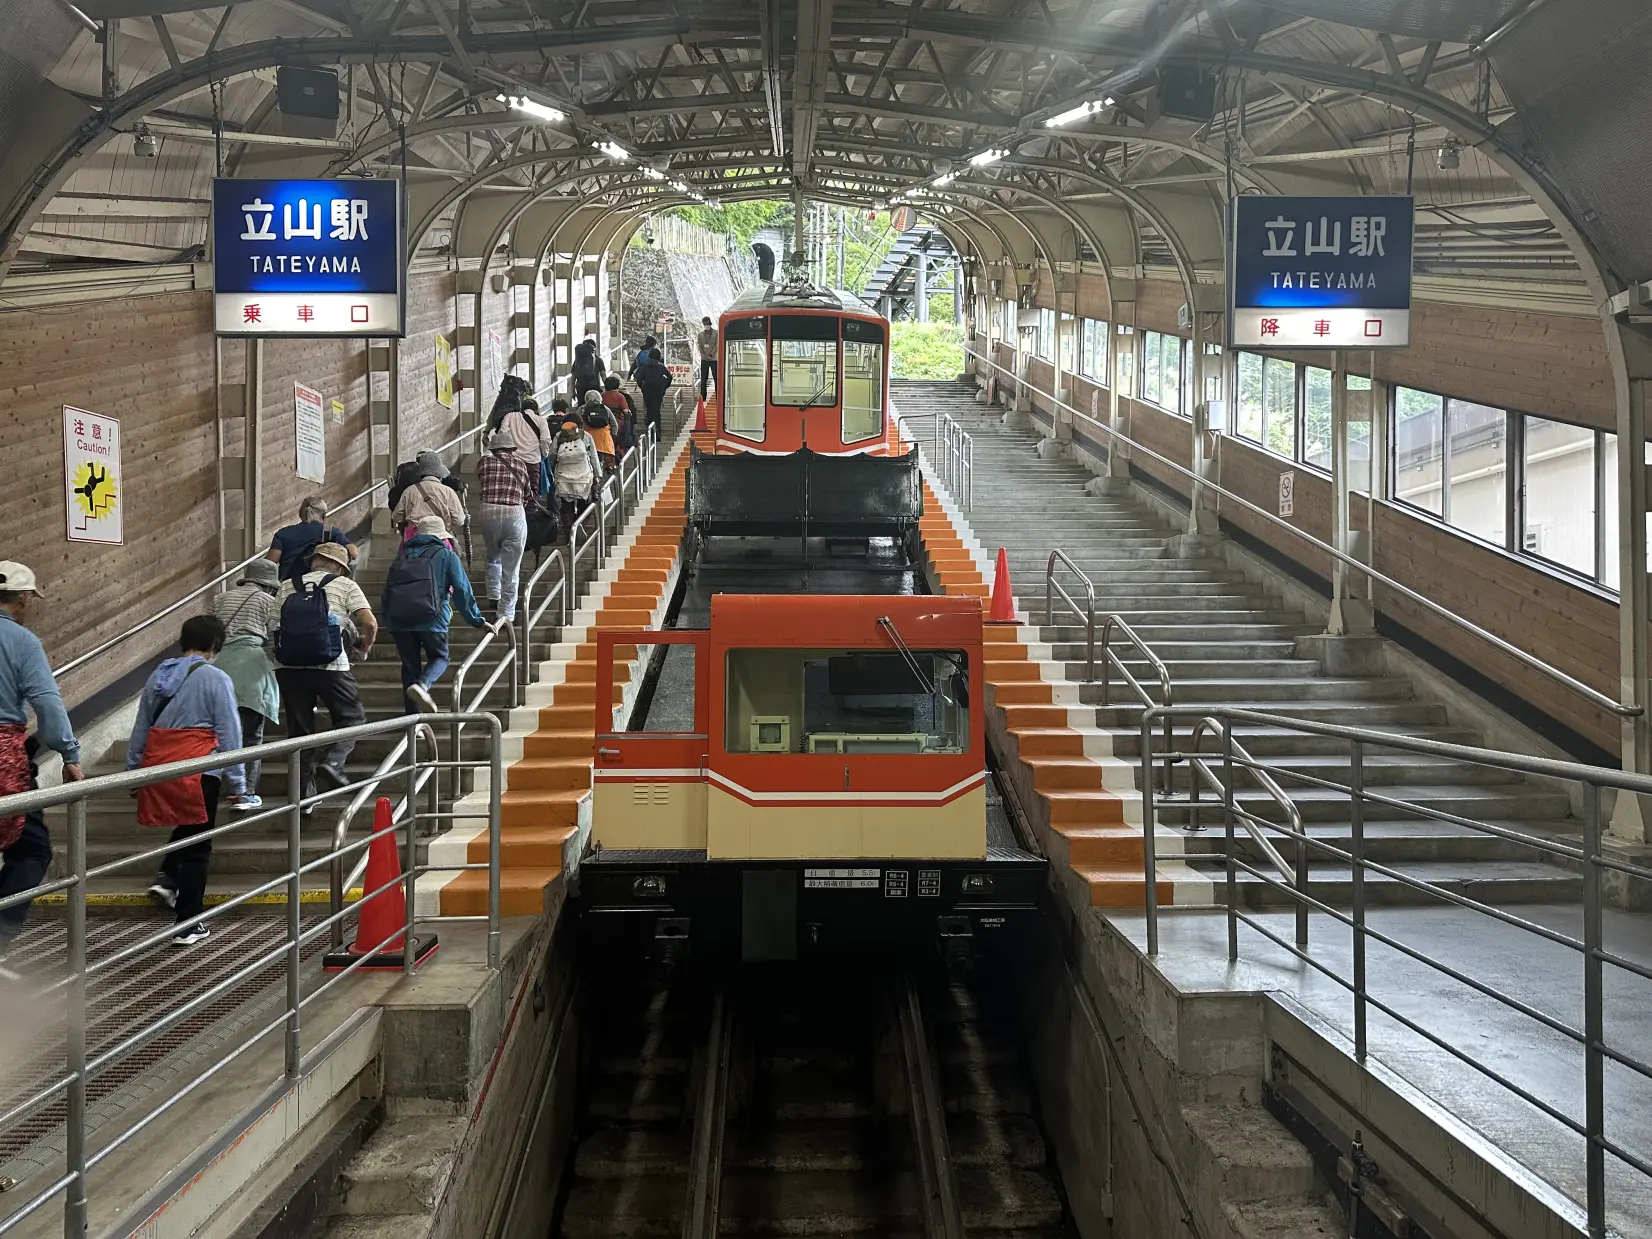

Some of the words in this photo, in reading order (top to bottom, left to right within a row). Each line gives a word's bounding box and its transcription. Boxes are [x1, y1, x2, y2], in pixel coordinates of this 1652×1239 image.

[240, 197, 369, 241] 立山駅
[1262, 215, 1387, 257] 立山駅
[249, 255, 361, 273] TATEYAMA
[1270, 271, 1377, 289] TATEYAMA
[243, 303, 369, 323] 乗車口
[1261, 318, 1382, 337] 降車口
[77, 438, 111, 456] Caution!
